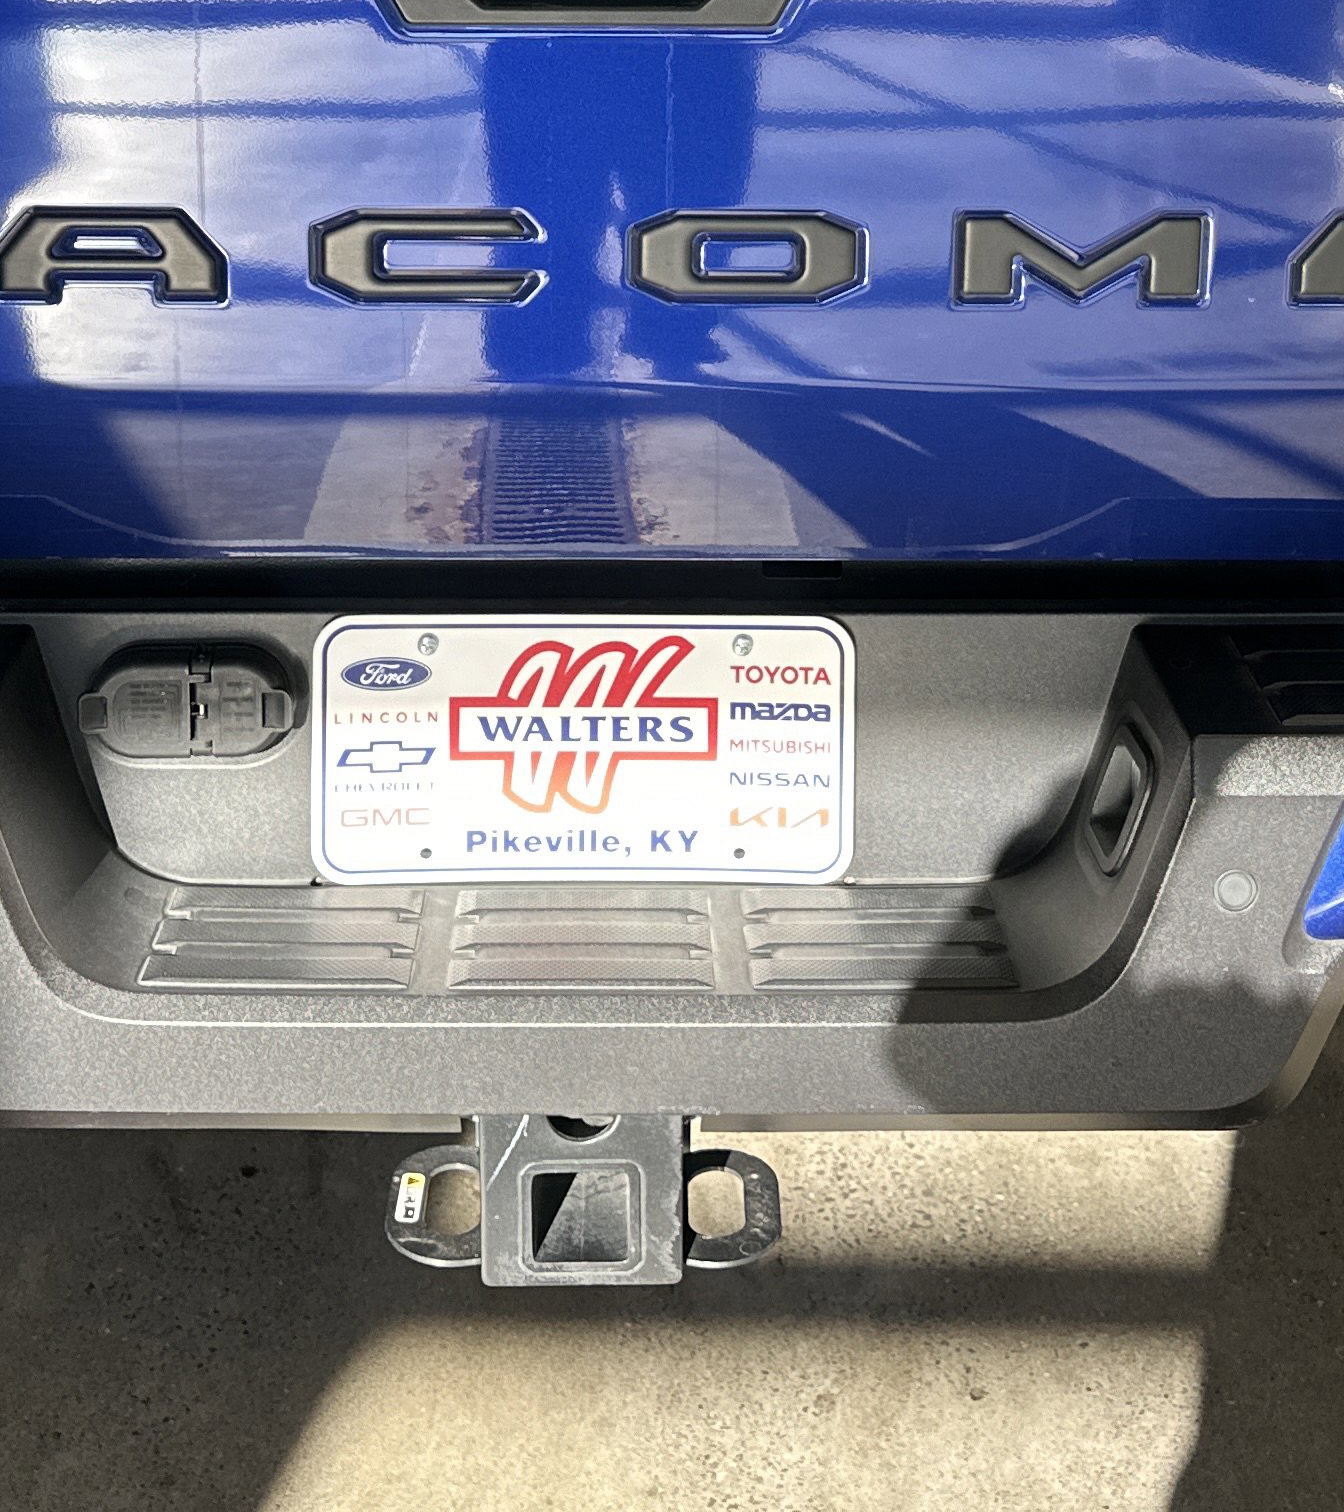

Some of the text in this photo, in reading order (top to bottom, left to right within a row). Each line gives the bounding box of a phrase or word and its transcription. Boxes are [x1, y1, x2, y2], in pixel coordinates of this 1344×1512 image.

[359, 660, 413, 686] Ford
[730, 665, 831, 686] TOYOTA
[334, 711, 438, 724] LINCOLN
[478, 715, 694, 743] WALTERS
[729, 739, 830, 754] MITSUBISHI
[729, 772, 830, 788] NISSAN
[341, 807, 430, 827] GMC
[466, 830, 699, 857] Pikeville, KY
